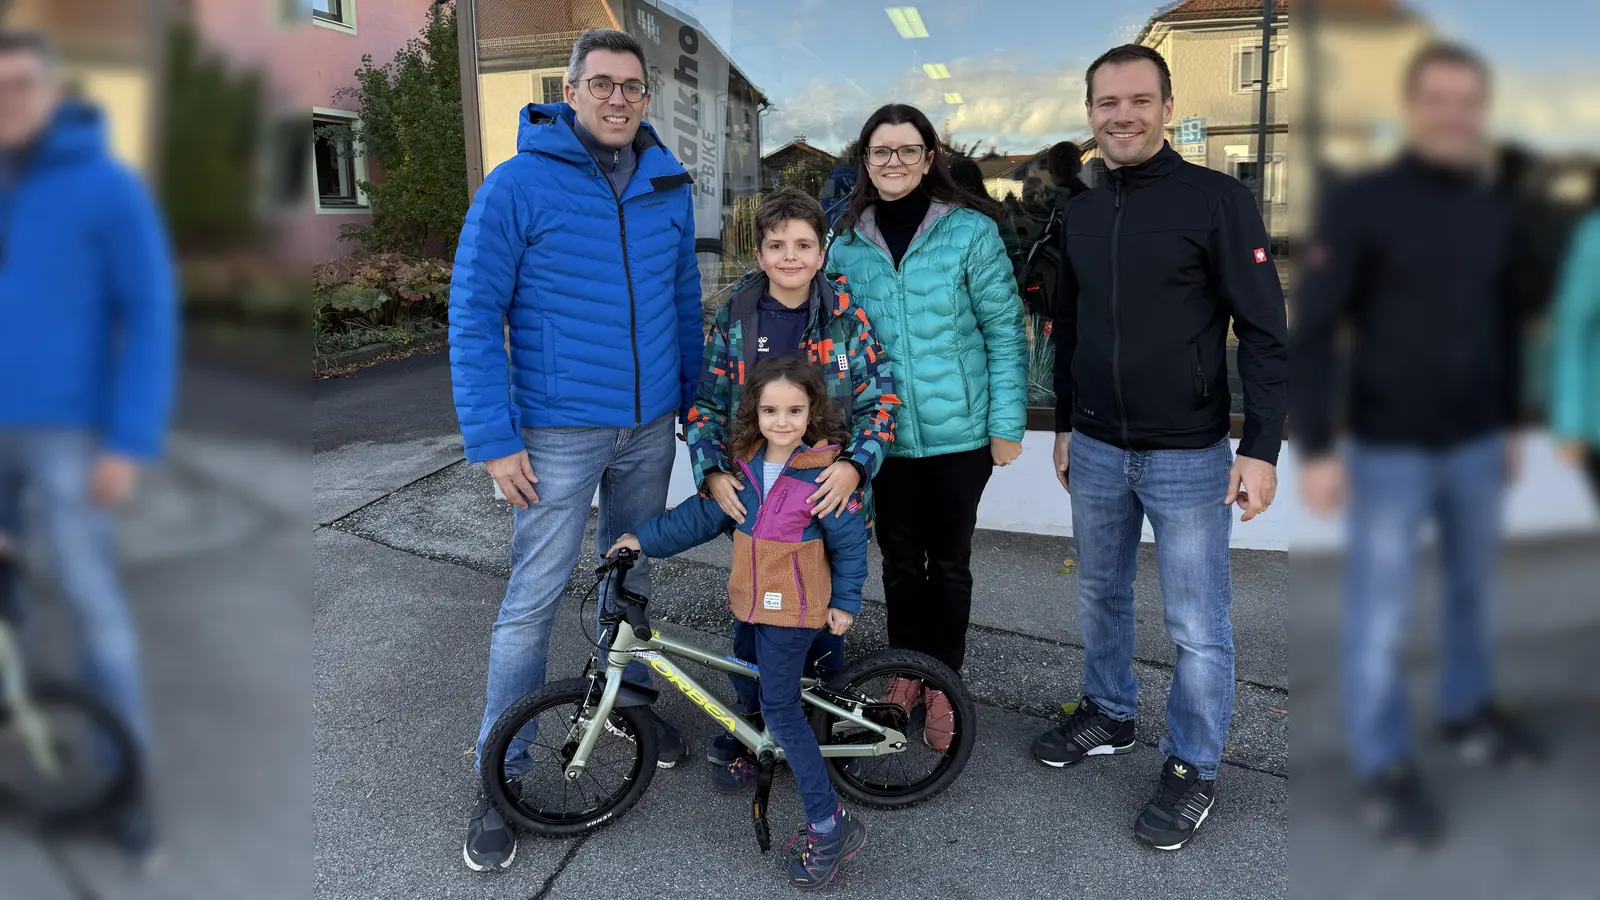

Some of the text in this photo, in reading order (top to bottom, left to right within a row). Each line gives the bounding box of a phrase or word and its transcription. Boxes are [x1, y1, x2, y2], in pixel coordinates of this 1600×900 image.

[674, 25, 699, 196] alkho
[701, 129, 716, 198] E-BIKE
[650, 660, 736, 732] ORBEA
[586, 812, 612, 827] KENDA
